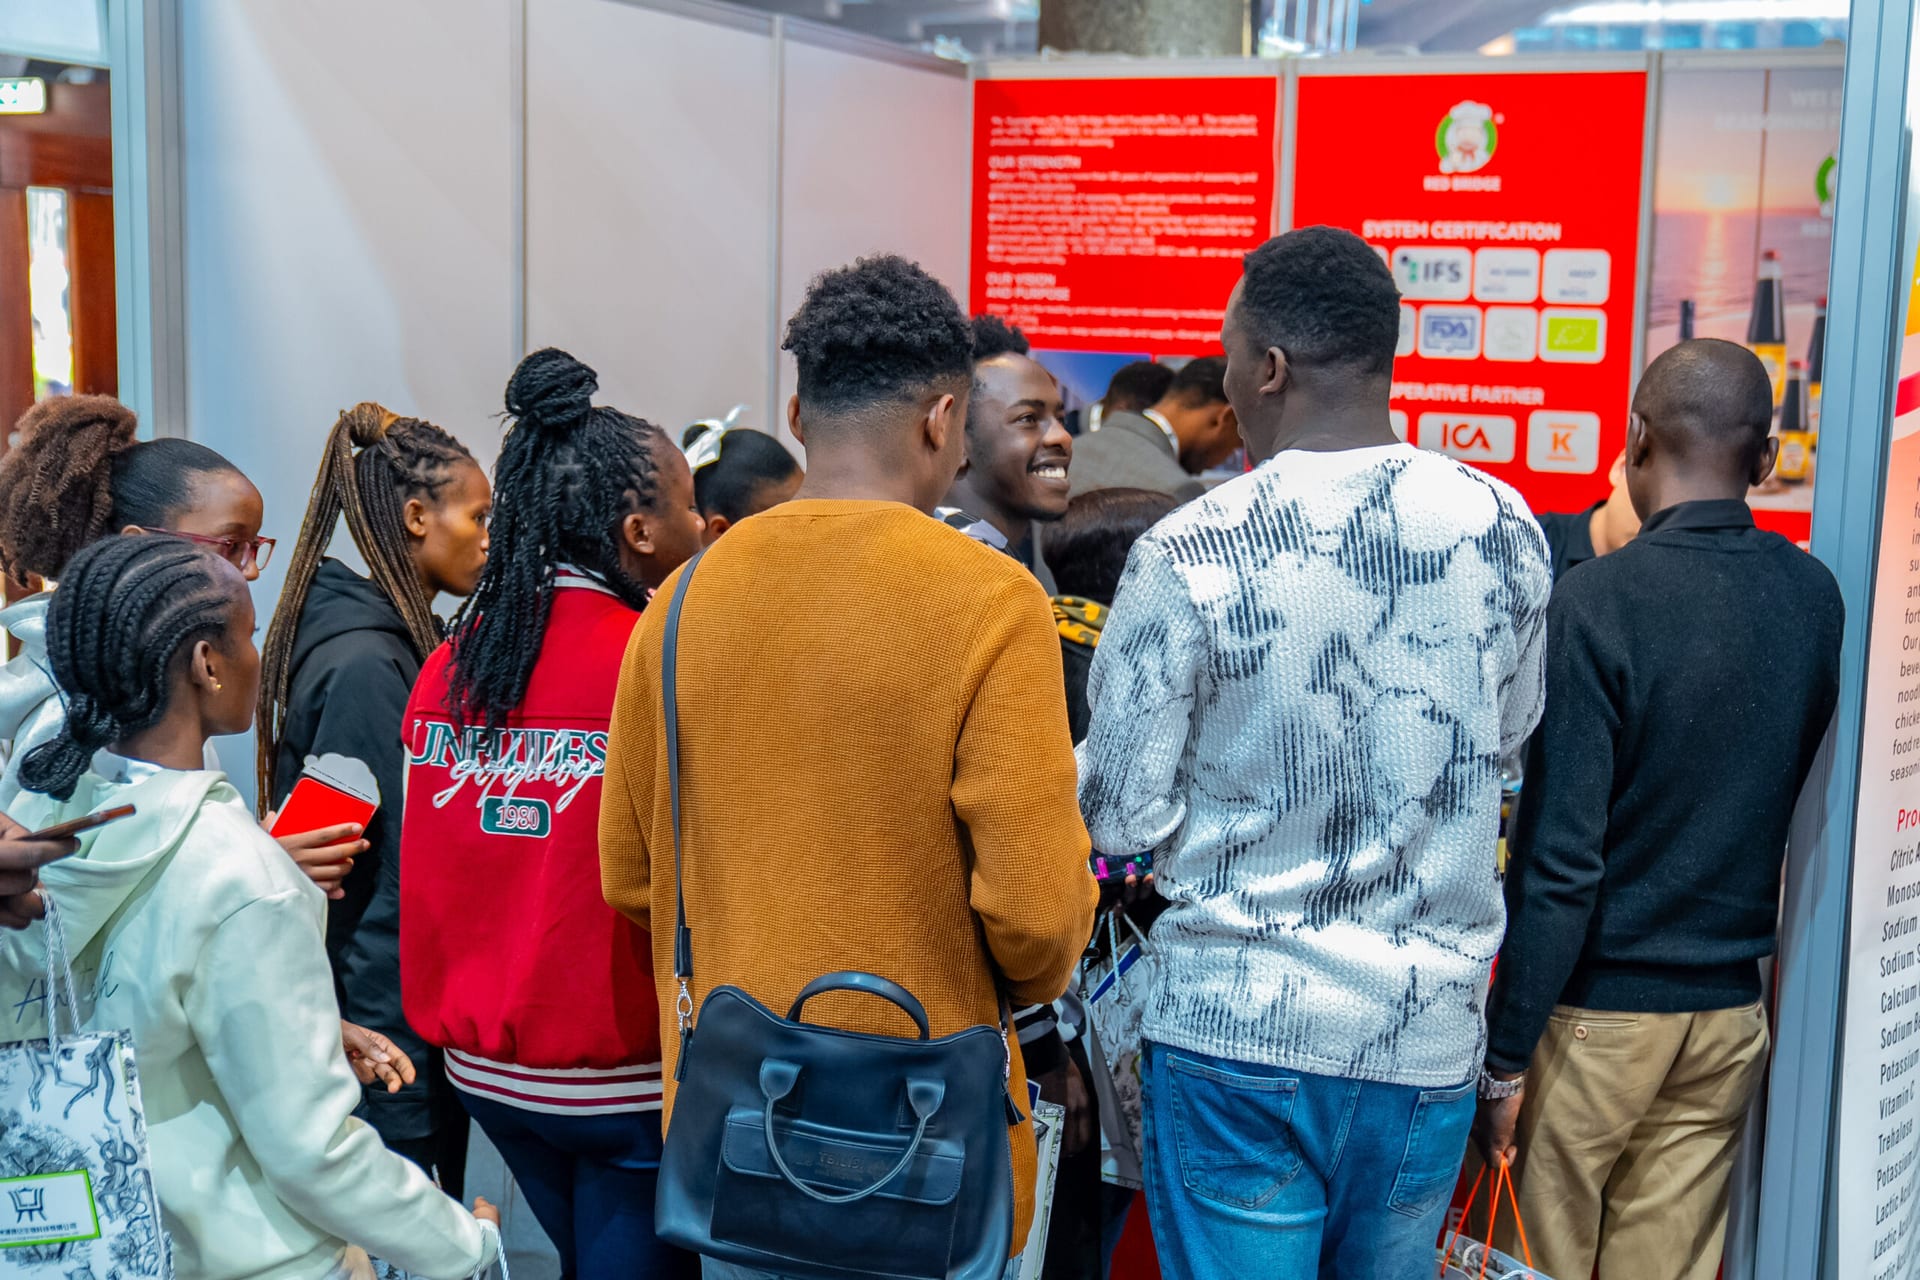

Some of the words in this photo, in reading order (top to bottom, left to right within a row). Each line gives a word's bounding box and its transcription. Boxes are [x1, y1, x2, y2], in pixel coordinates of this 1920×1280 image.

[1362, 219, 1429, 240] SYSTEM
[1431, 221, 1562, 241] CERTIFICATION
[1424, 261, 1461, 283] IFS
[1431, 320, 1468, 339] FDA
[1471, 386, 1545, 405] PARTNER
[1442, 422, 1491, 452] ICA
[1552, 431, 1572, 454] K
[1902, 634, 1918, 651] Our
[1892, 736, 1913, 756] food
[495, 805, 540, 830] 1980
[1890, 845, 1914, 872] Citric
[1881, 914, 1918, 943] Sodium
[1880, 950, 1915, 978] Sodium
[1880, 983, 1917, 1014] Calcium
[1880, 1020, 1913, 1050] Sodium
[1880, 1048, 1919, 1085] Potassium
[1879, 1087, 1909, 1120] Vitamin
[1878, 1118, 1913, 1156] Trehalose
